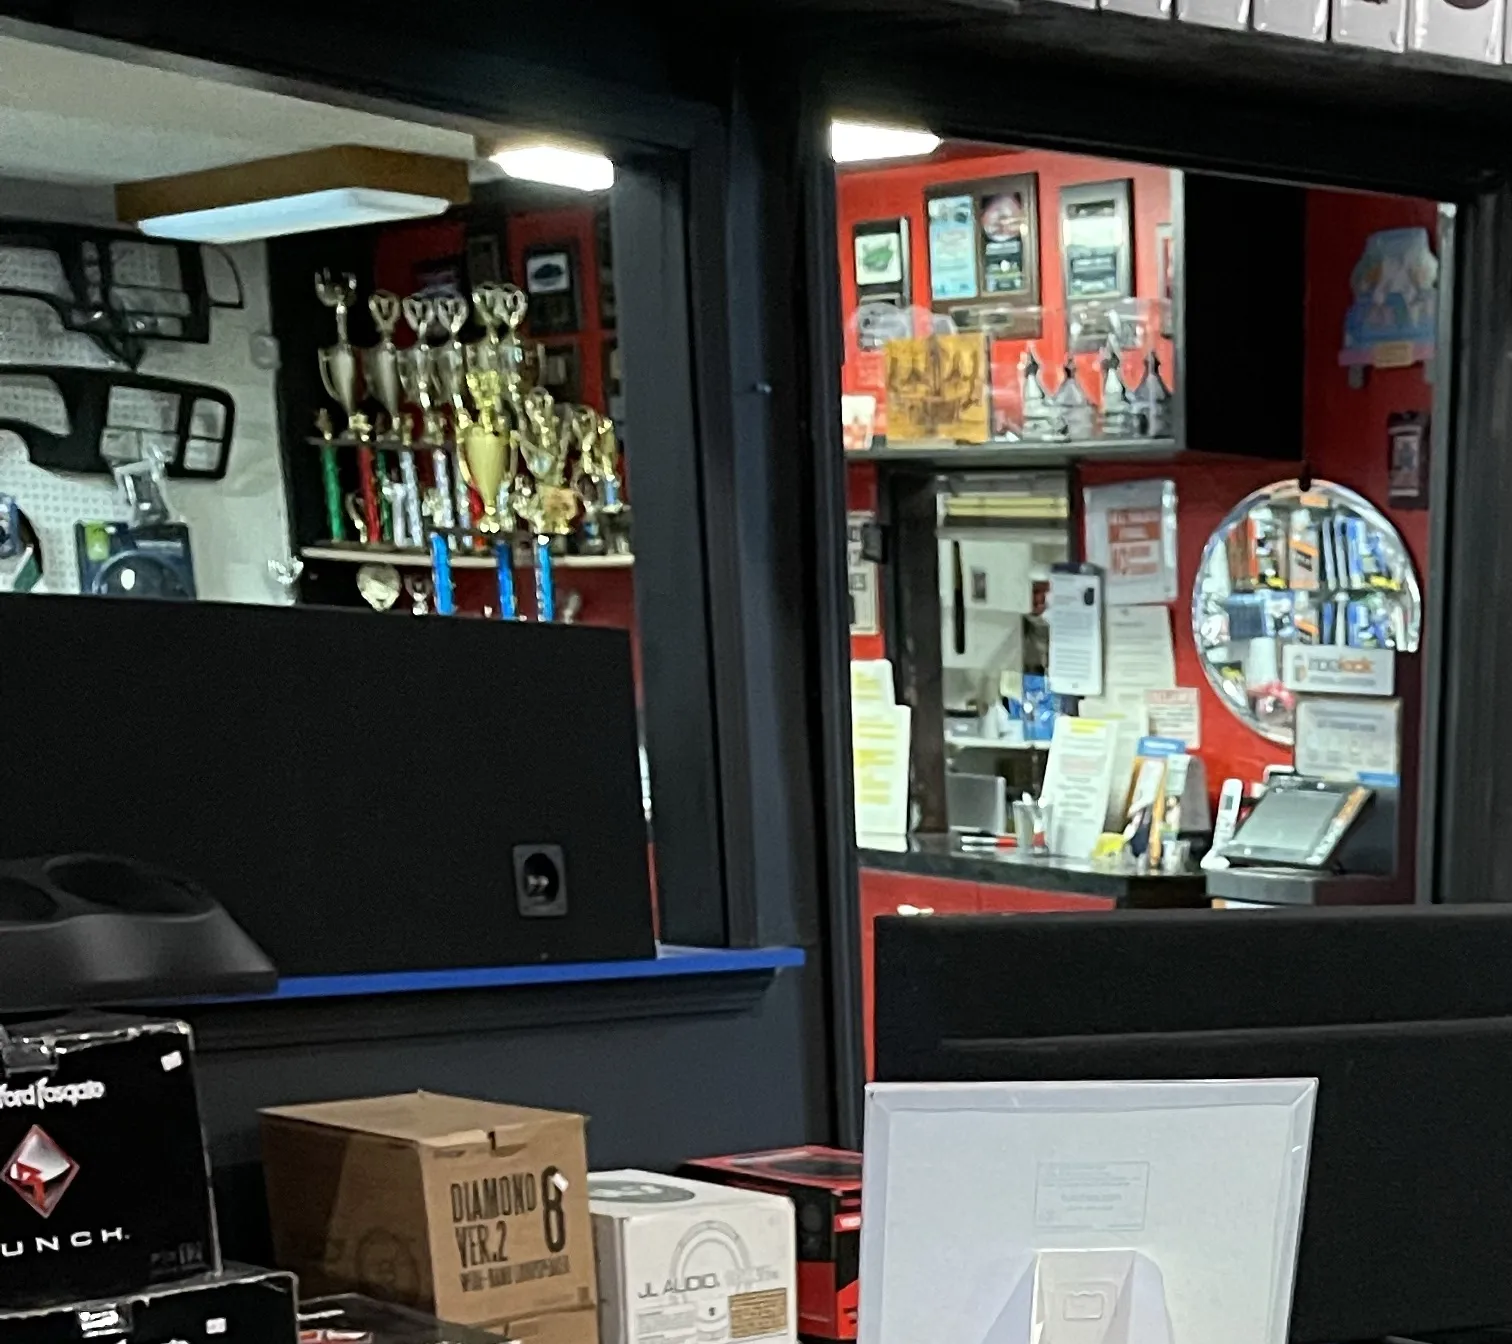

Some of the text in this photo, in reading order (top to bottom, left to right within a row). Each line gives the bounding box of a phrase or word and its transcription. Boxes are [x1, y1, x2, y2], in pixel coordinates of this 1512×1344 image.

[451, 1165, 567, 1252] DIAMOND 8
[455, 1220, 508, 1268] VER.2
